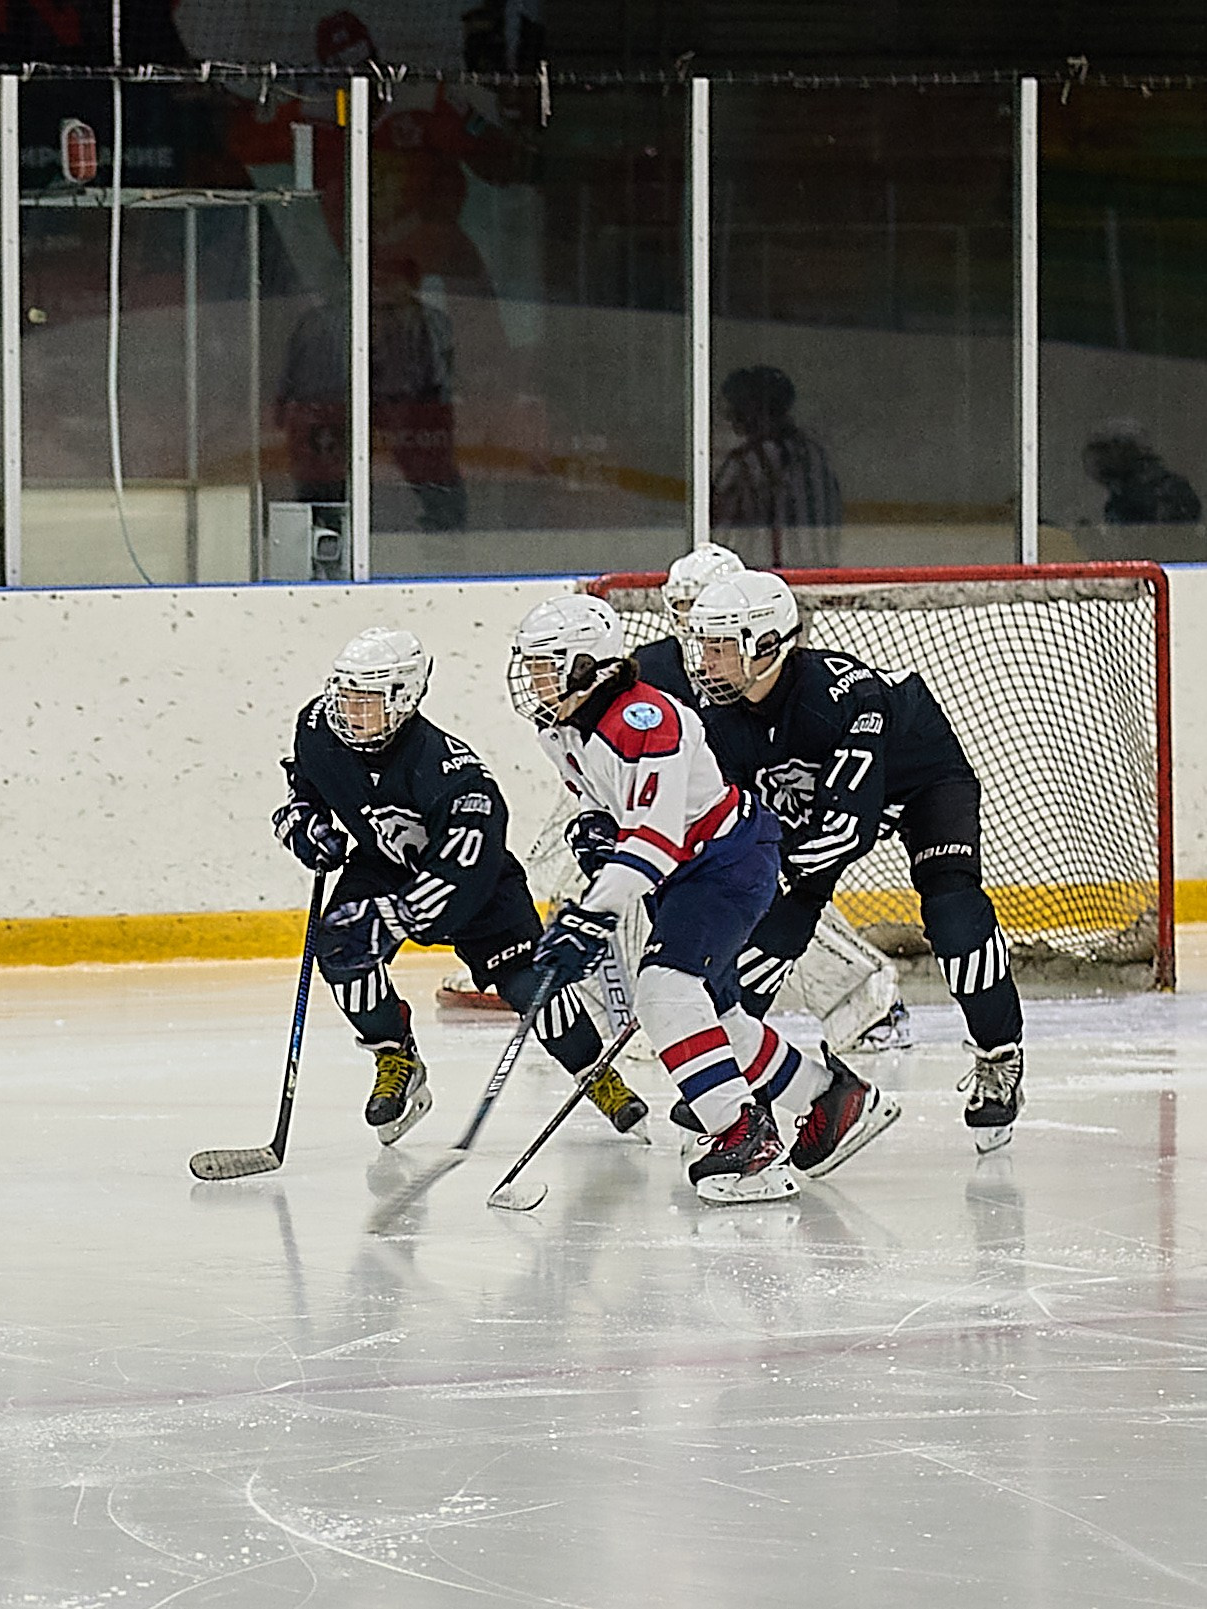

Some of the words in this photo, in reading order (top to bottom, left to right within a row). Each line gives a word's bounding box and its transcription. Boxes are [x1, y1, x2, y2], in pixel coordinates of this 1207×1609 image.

[825, 749, 873, 791] 77
[626, 771, 659, 811] 14
[439, 826, 484, 867] 70
[486, 940, 532, 970] CCM
